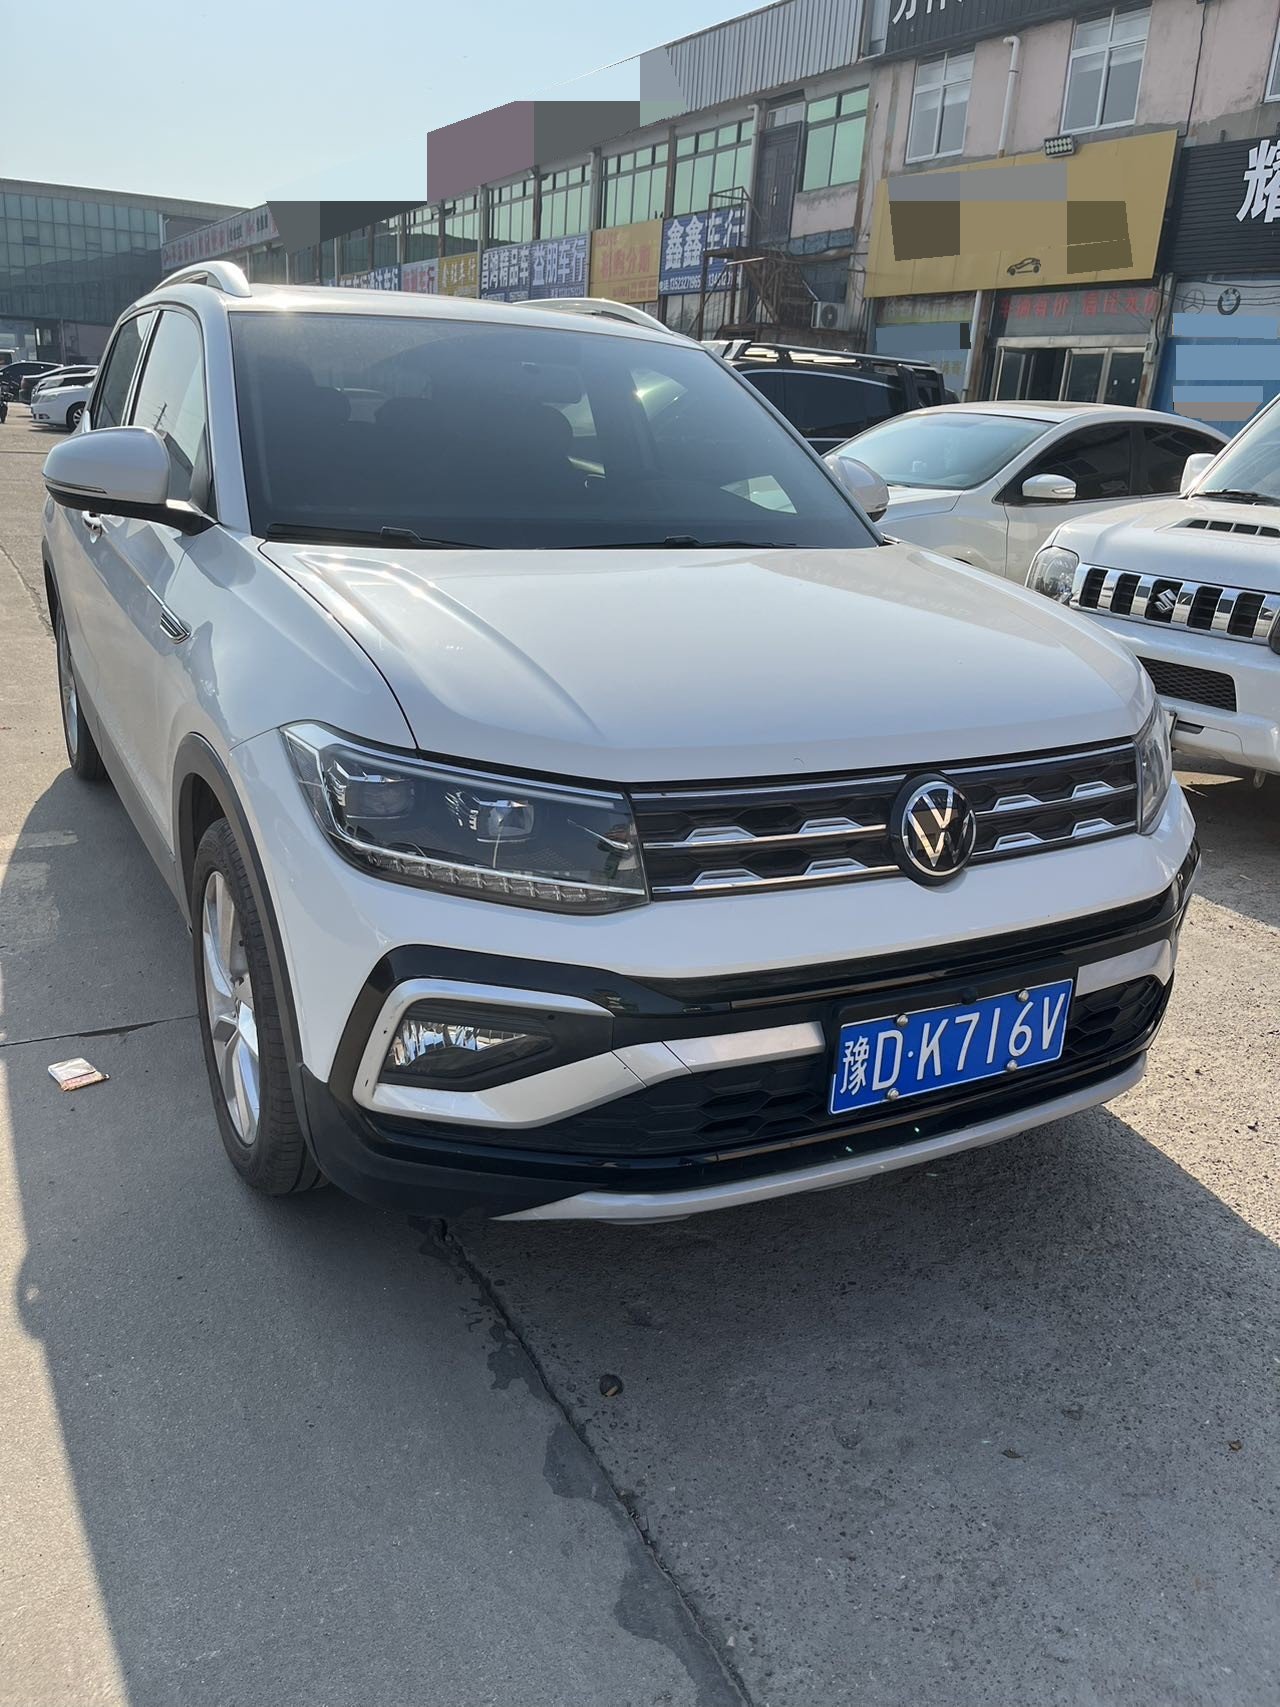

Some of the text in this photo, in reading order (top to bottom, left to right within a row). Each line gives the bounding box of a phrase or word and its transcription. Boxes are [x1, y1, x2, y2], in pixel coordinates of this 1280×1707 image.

[664, 208, 746, 271] 鑫鑫车行
[840, 993, 1066, 1097] 豫D·K716V
